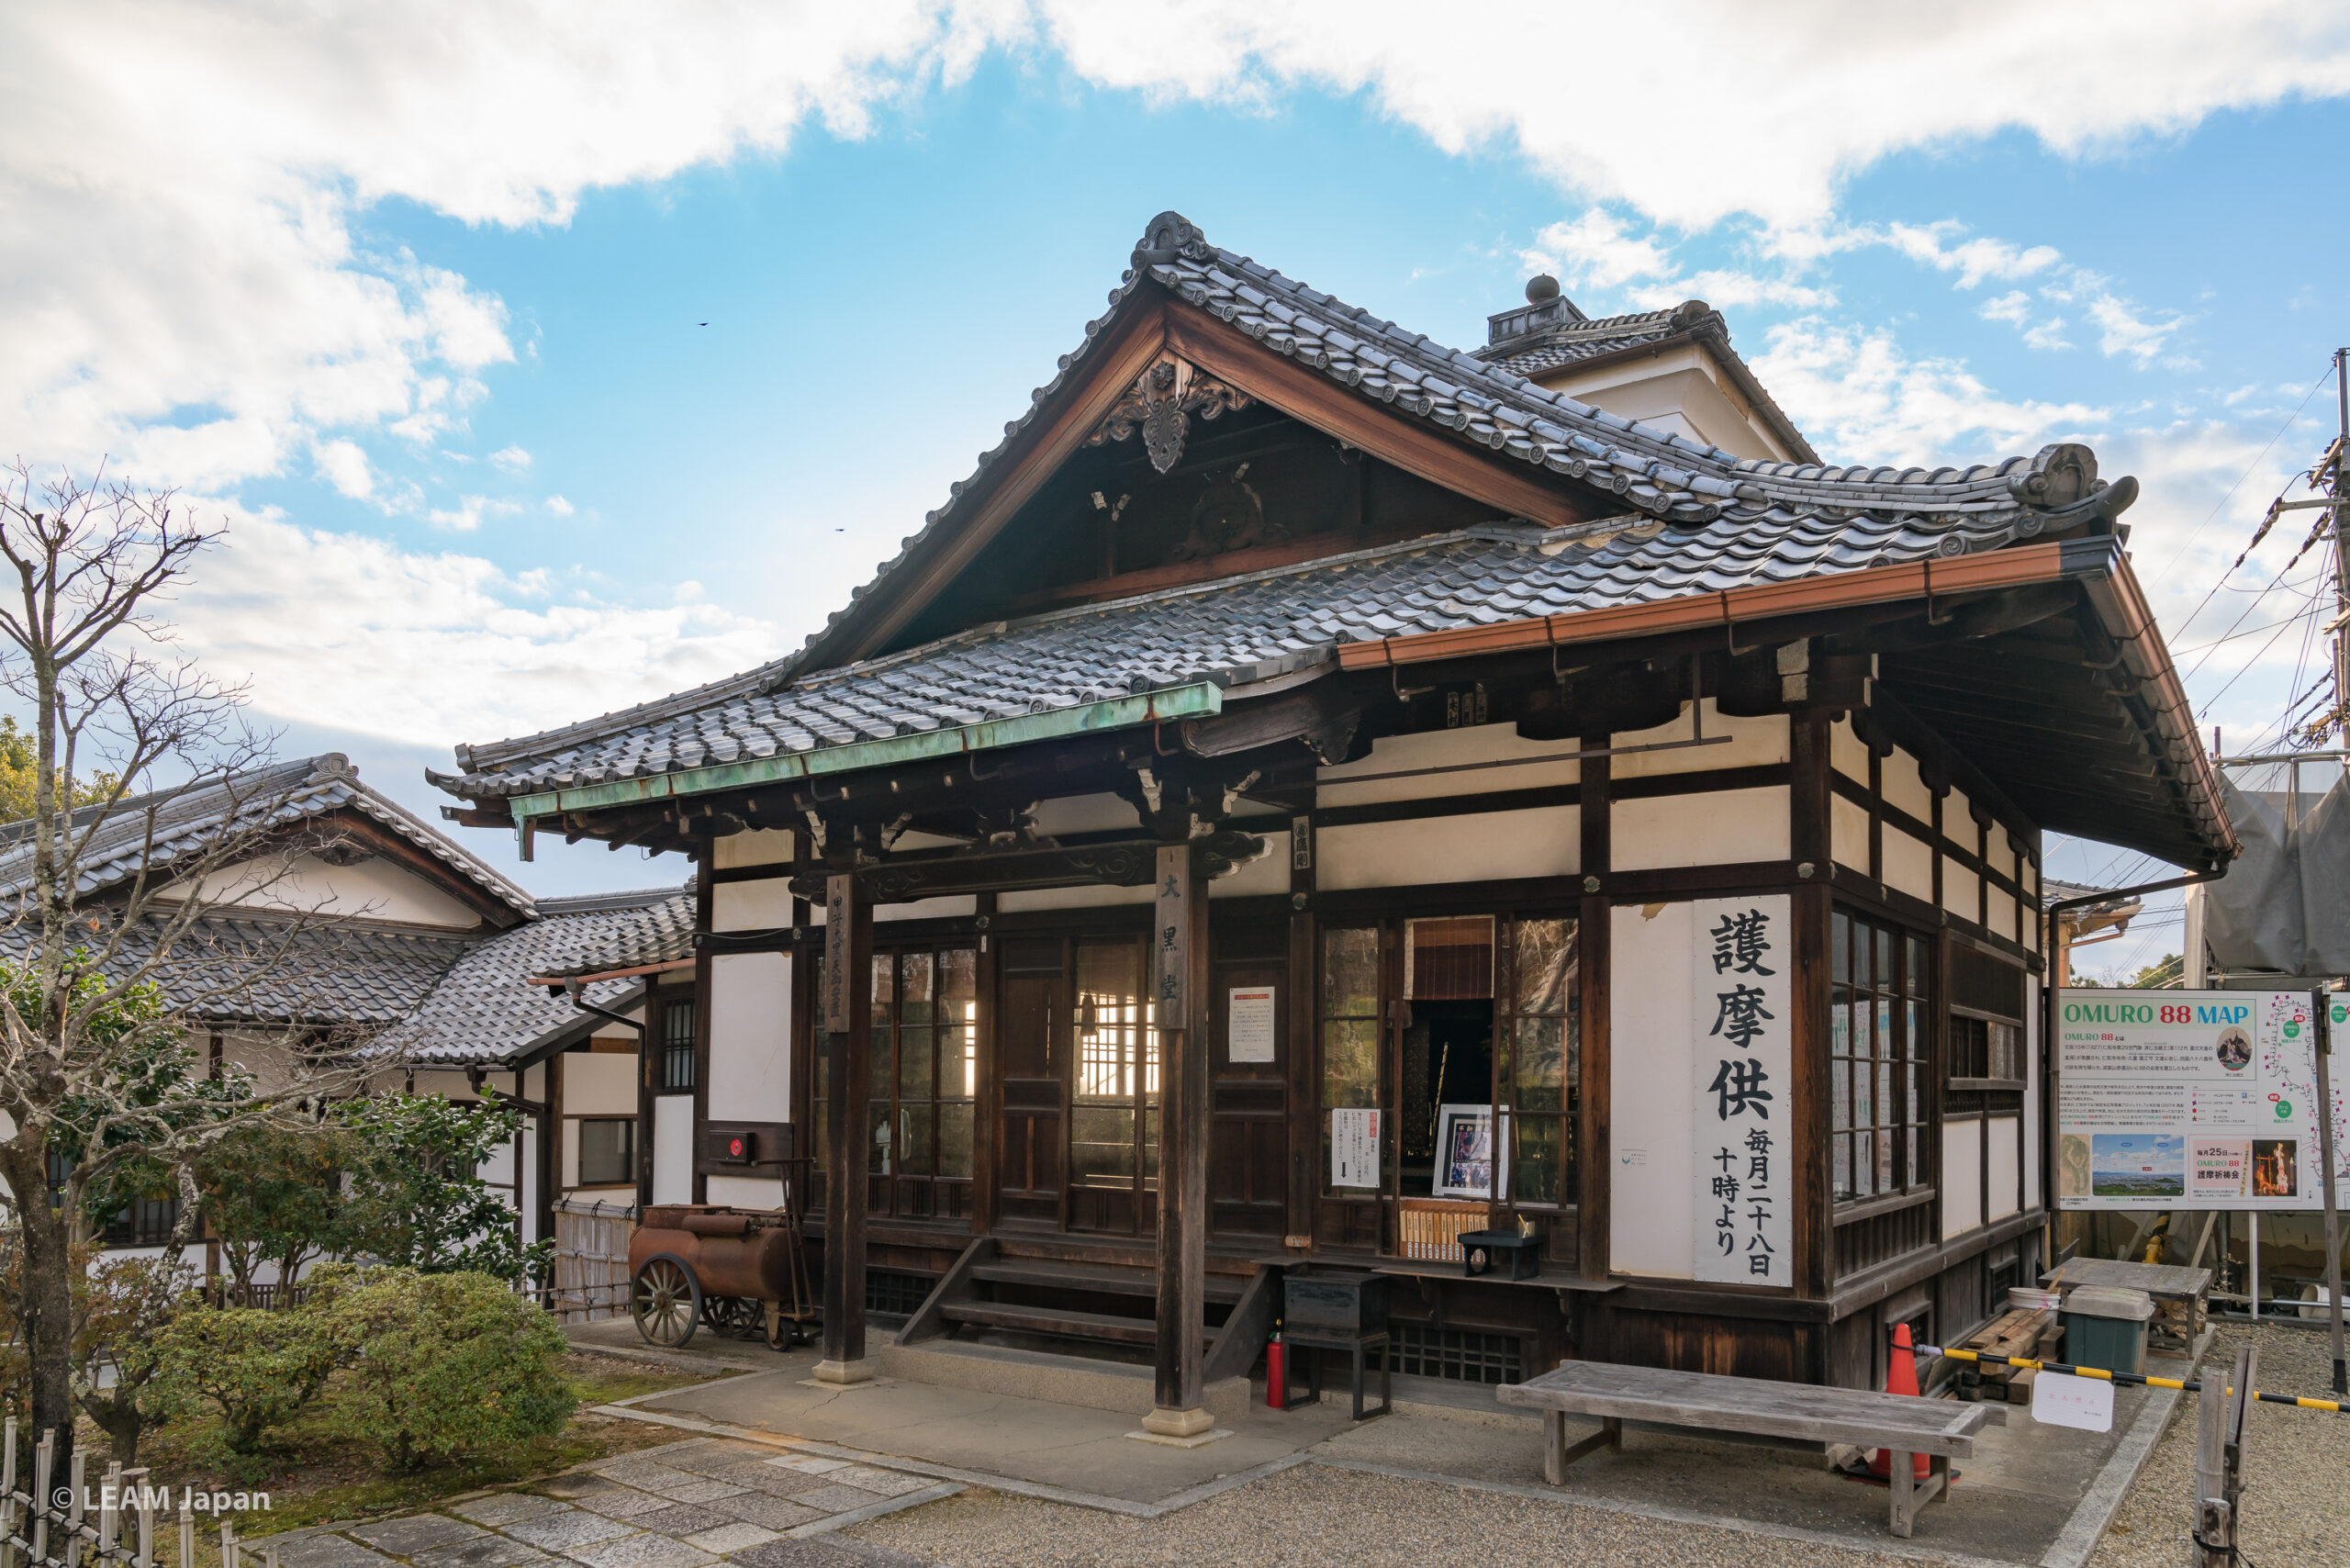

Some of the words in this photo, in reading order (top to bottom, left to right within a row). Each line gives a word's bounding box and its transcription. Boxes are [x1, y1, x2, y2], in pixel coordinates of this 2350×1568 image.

[1160, 873, 1181, 1001] 大黒堂
[1707, 908, 1776, 1122] 護摩供
[2065, 1003, 2154, 1024] OMURO
[2160, 1005, 2191, 1024] 88
[2198, 1005, 2248, 1025] MAP
[2065, 1033, 2099, 1041] OMURO
[2100, 1033, 2114, 1041] 88
[1711, 1147, 1740, 1257] 十時より
[1743, 1127, 1775, 1277] 毎月二十八日
